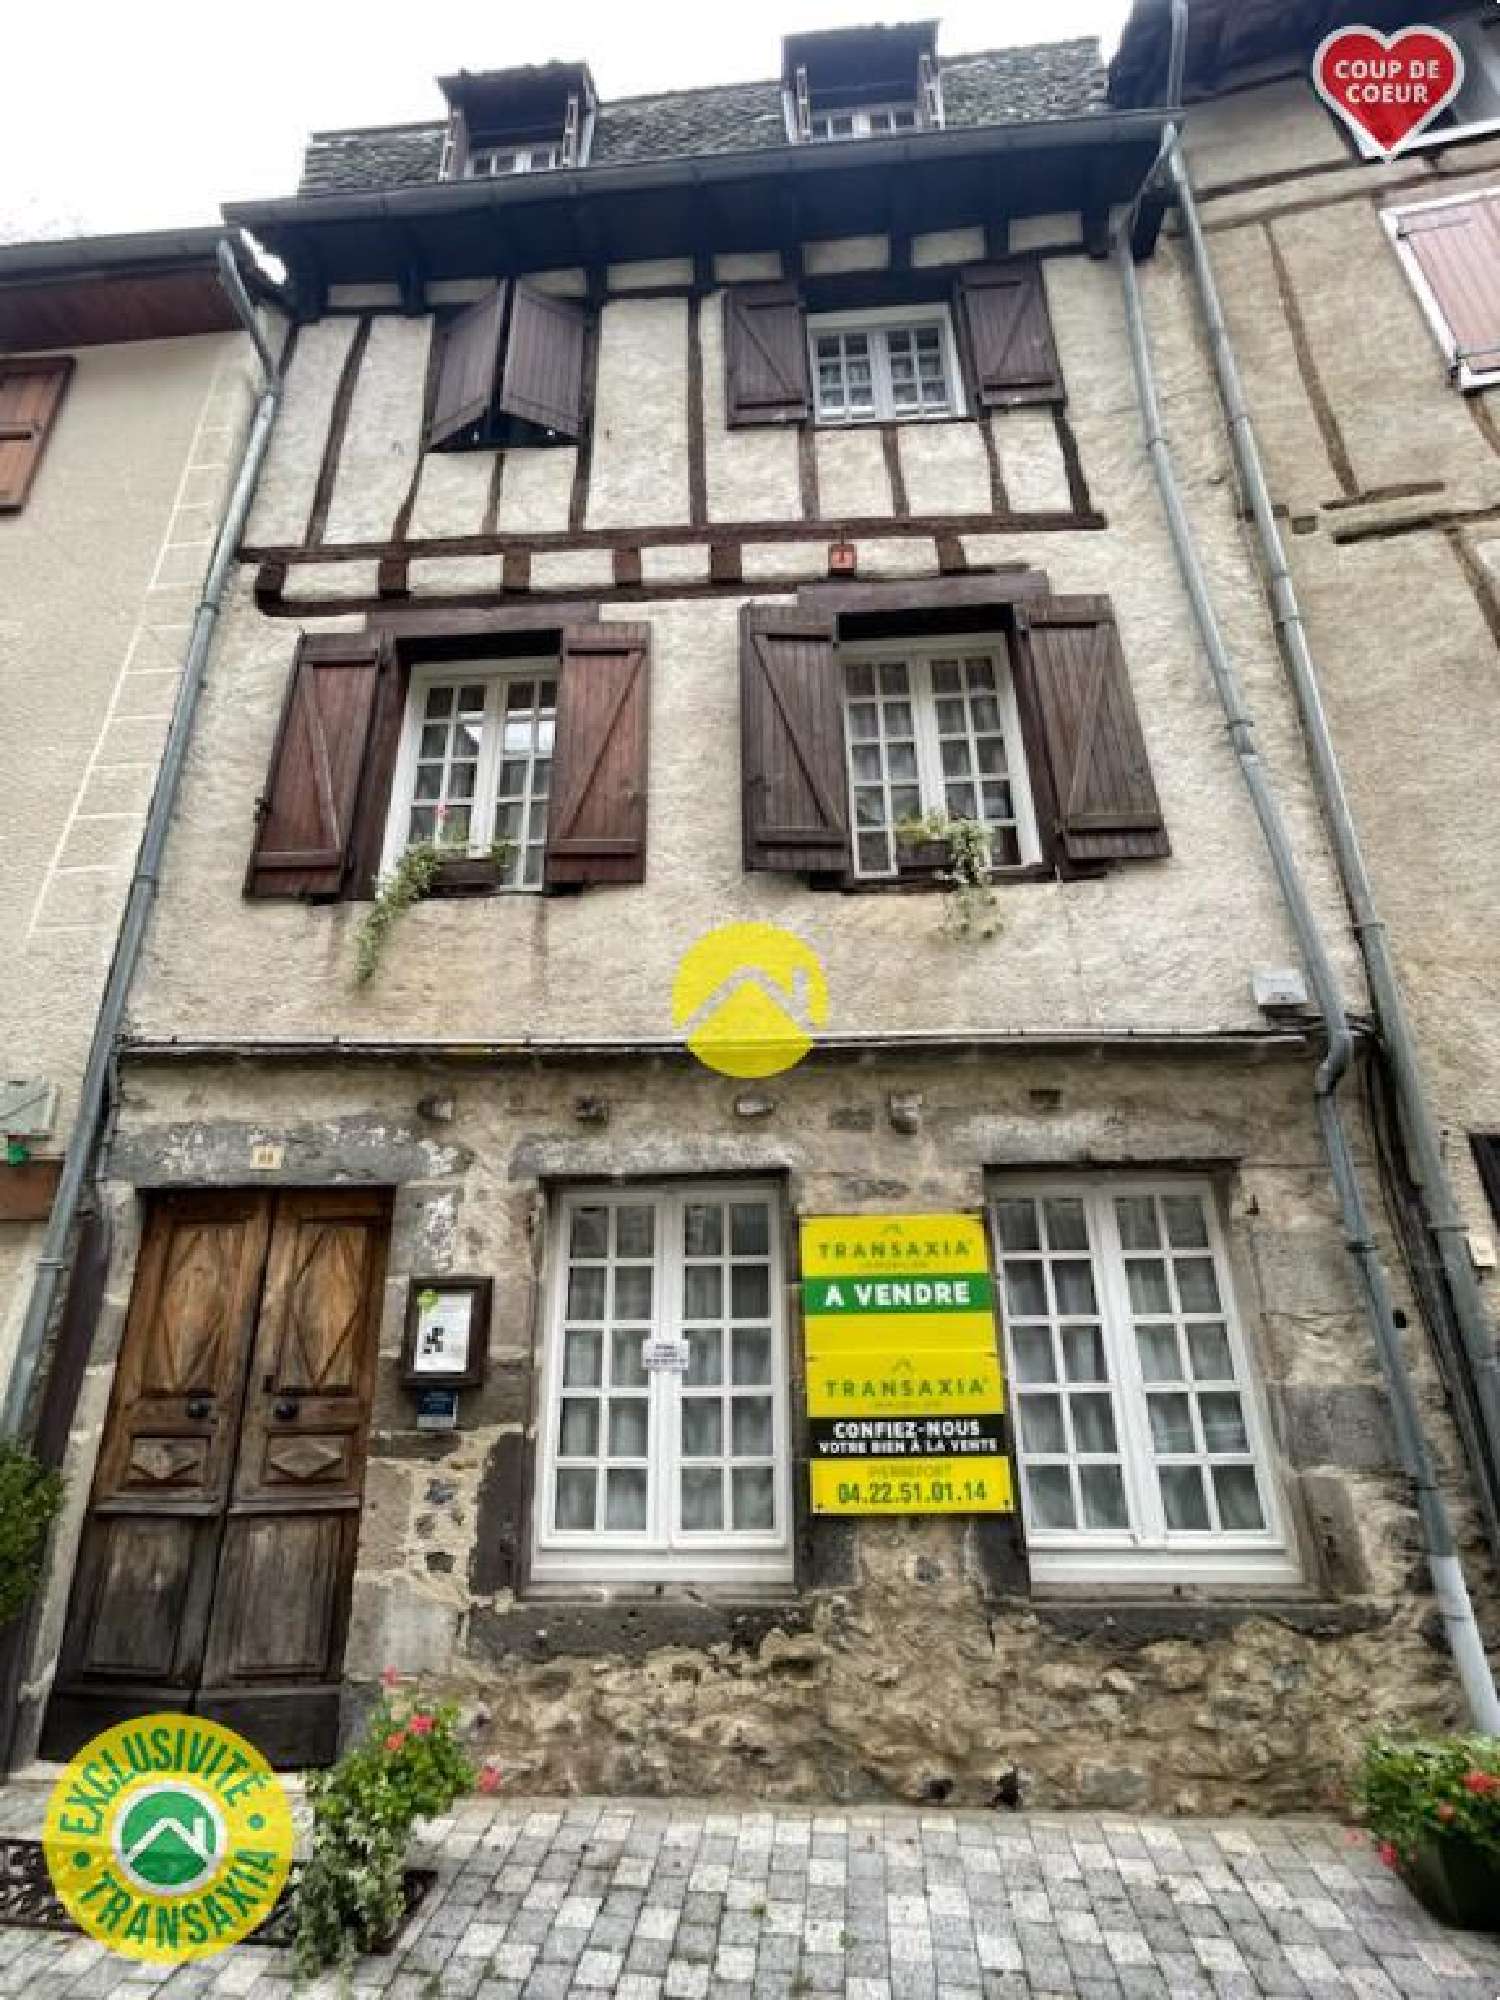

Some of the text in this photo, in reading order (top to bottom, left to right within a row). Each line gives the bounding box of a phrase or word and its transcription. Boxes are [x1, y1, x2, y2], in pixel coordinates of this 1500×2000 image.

[818, 1239, 970, 1259] TRANSAXIA
[825, 1281, 971, 1307] A VENDRE
[826, 1378, 985, 1398] TRANSAXIA
[833, 1419, 980, 1438] CONFIEZ-NOUS
[818, 1441, 867, 1454] VOTRE
[871, 1440, 905, 1454] BIEN
[926, 1439, 946, 1452] LA
[950, 1438, 998, 1452] VENTE
[838, 1480, 986, 1505] 04.22.51.01.14
